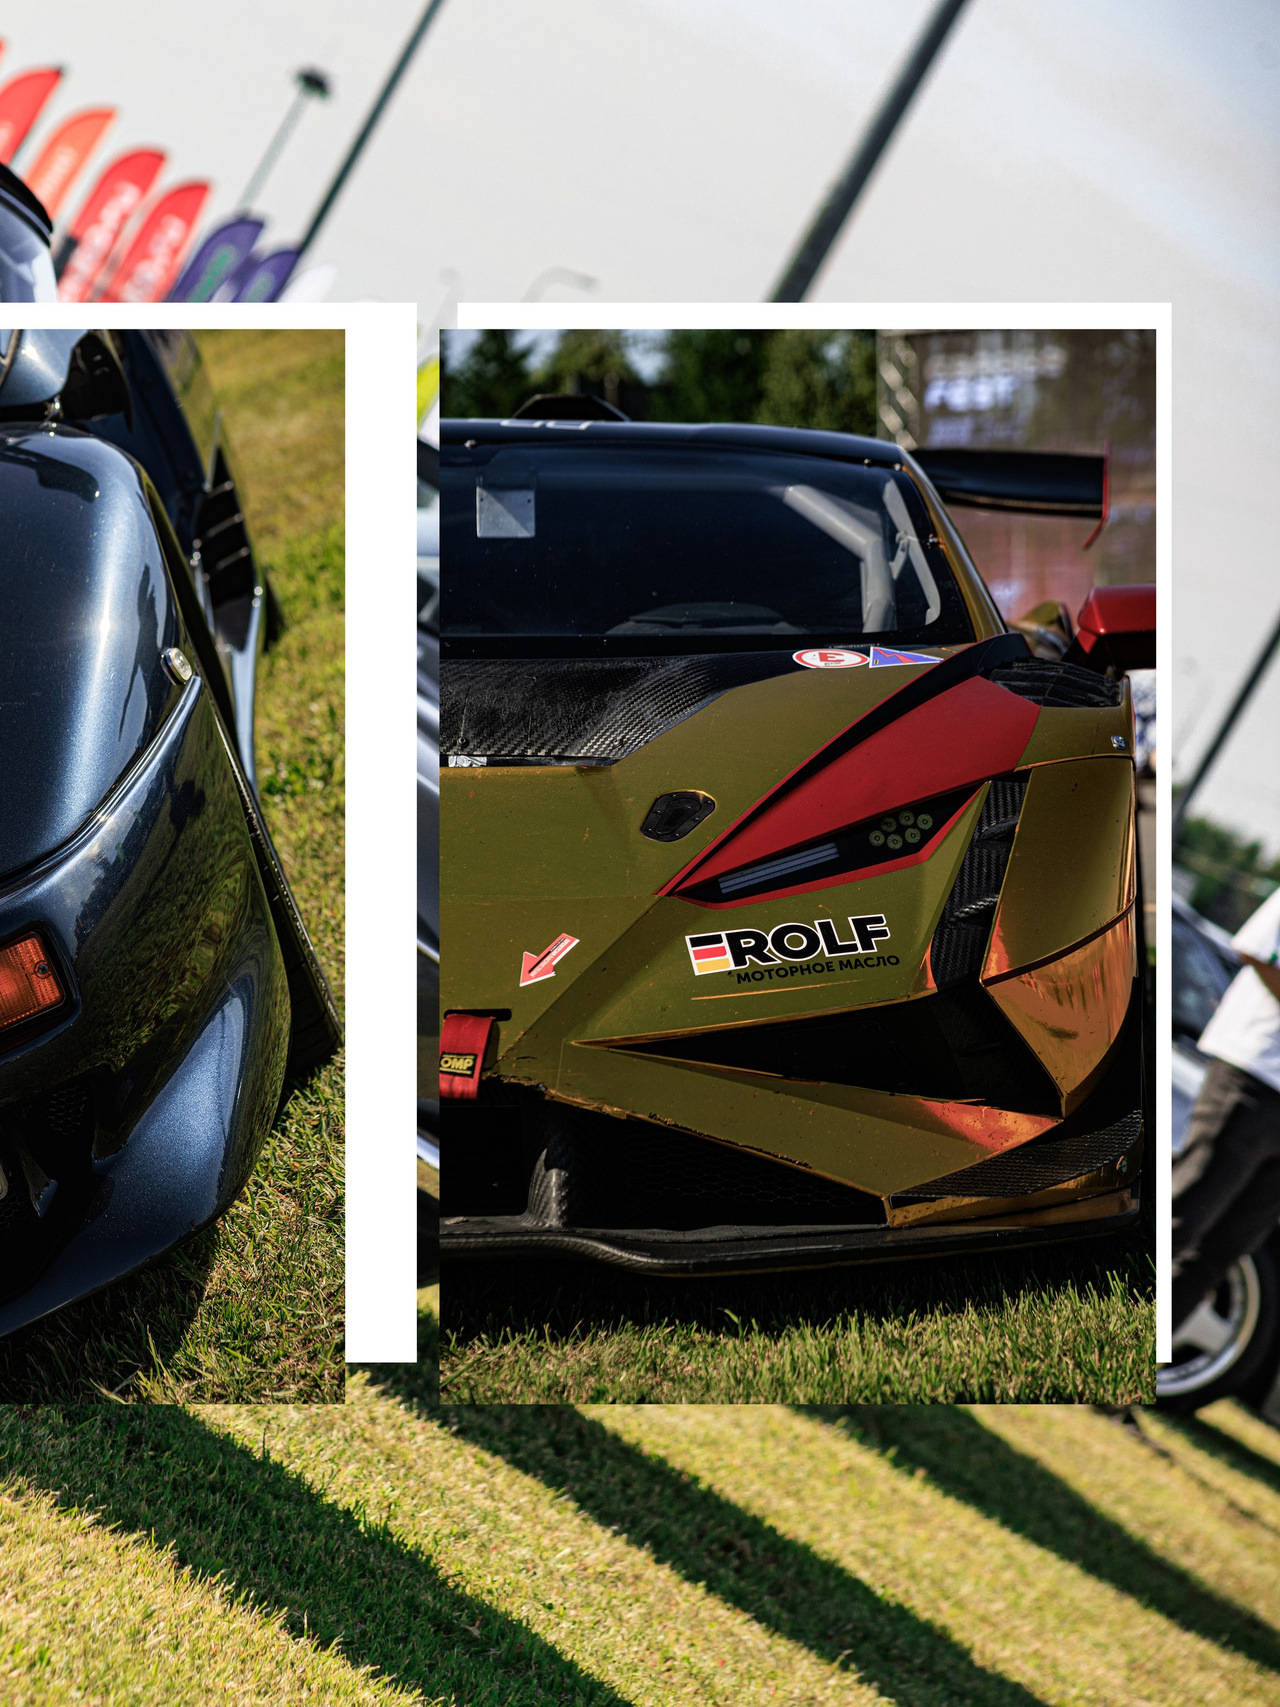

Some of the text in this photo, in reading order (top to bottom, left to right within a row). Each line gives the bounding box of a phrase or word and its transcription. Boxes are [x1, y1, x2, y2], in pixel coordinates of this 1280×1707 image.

[724, 914, 891, 968] ROLF
[736, 954, 901, 985] МОТОРНОЕ МАСЛО
[440, 1056, 474, 1070] OMP
